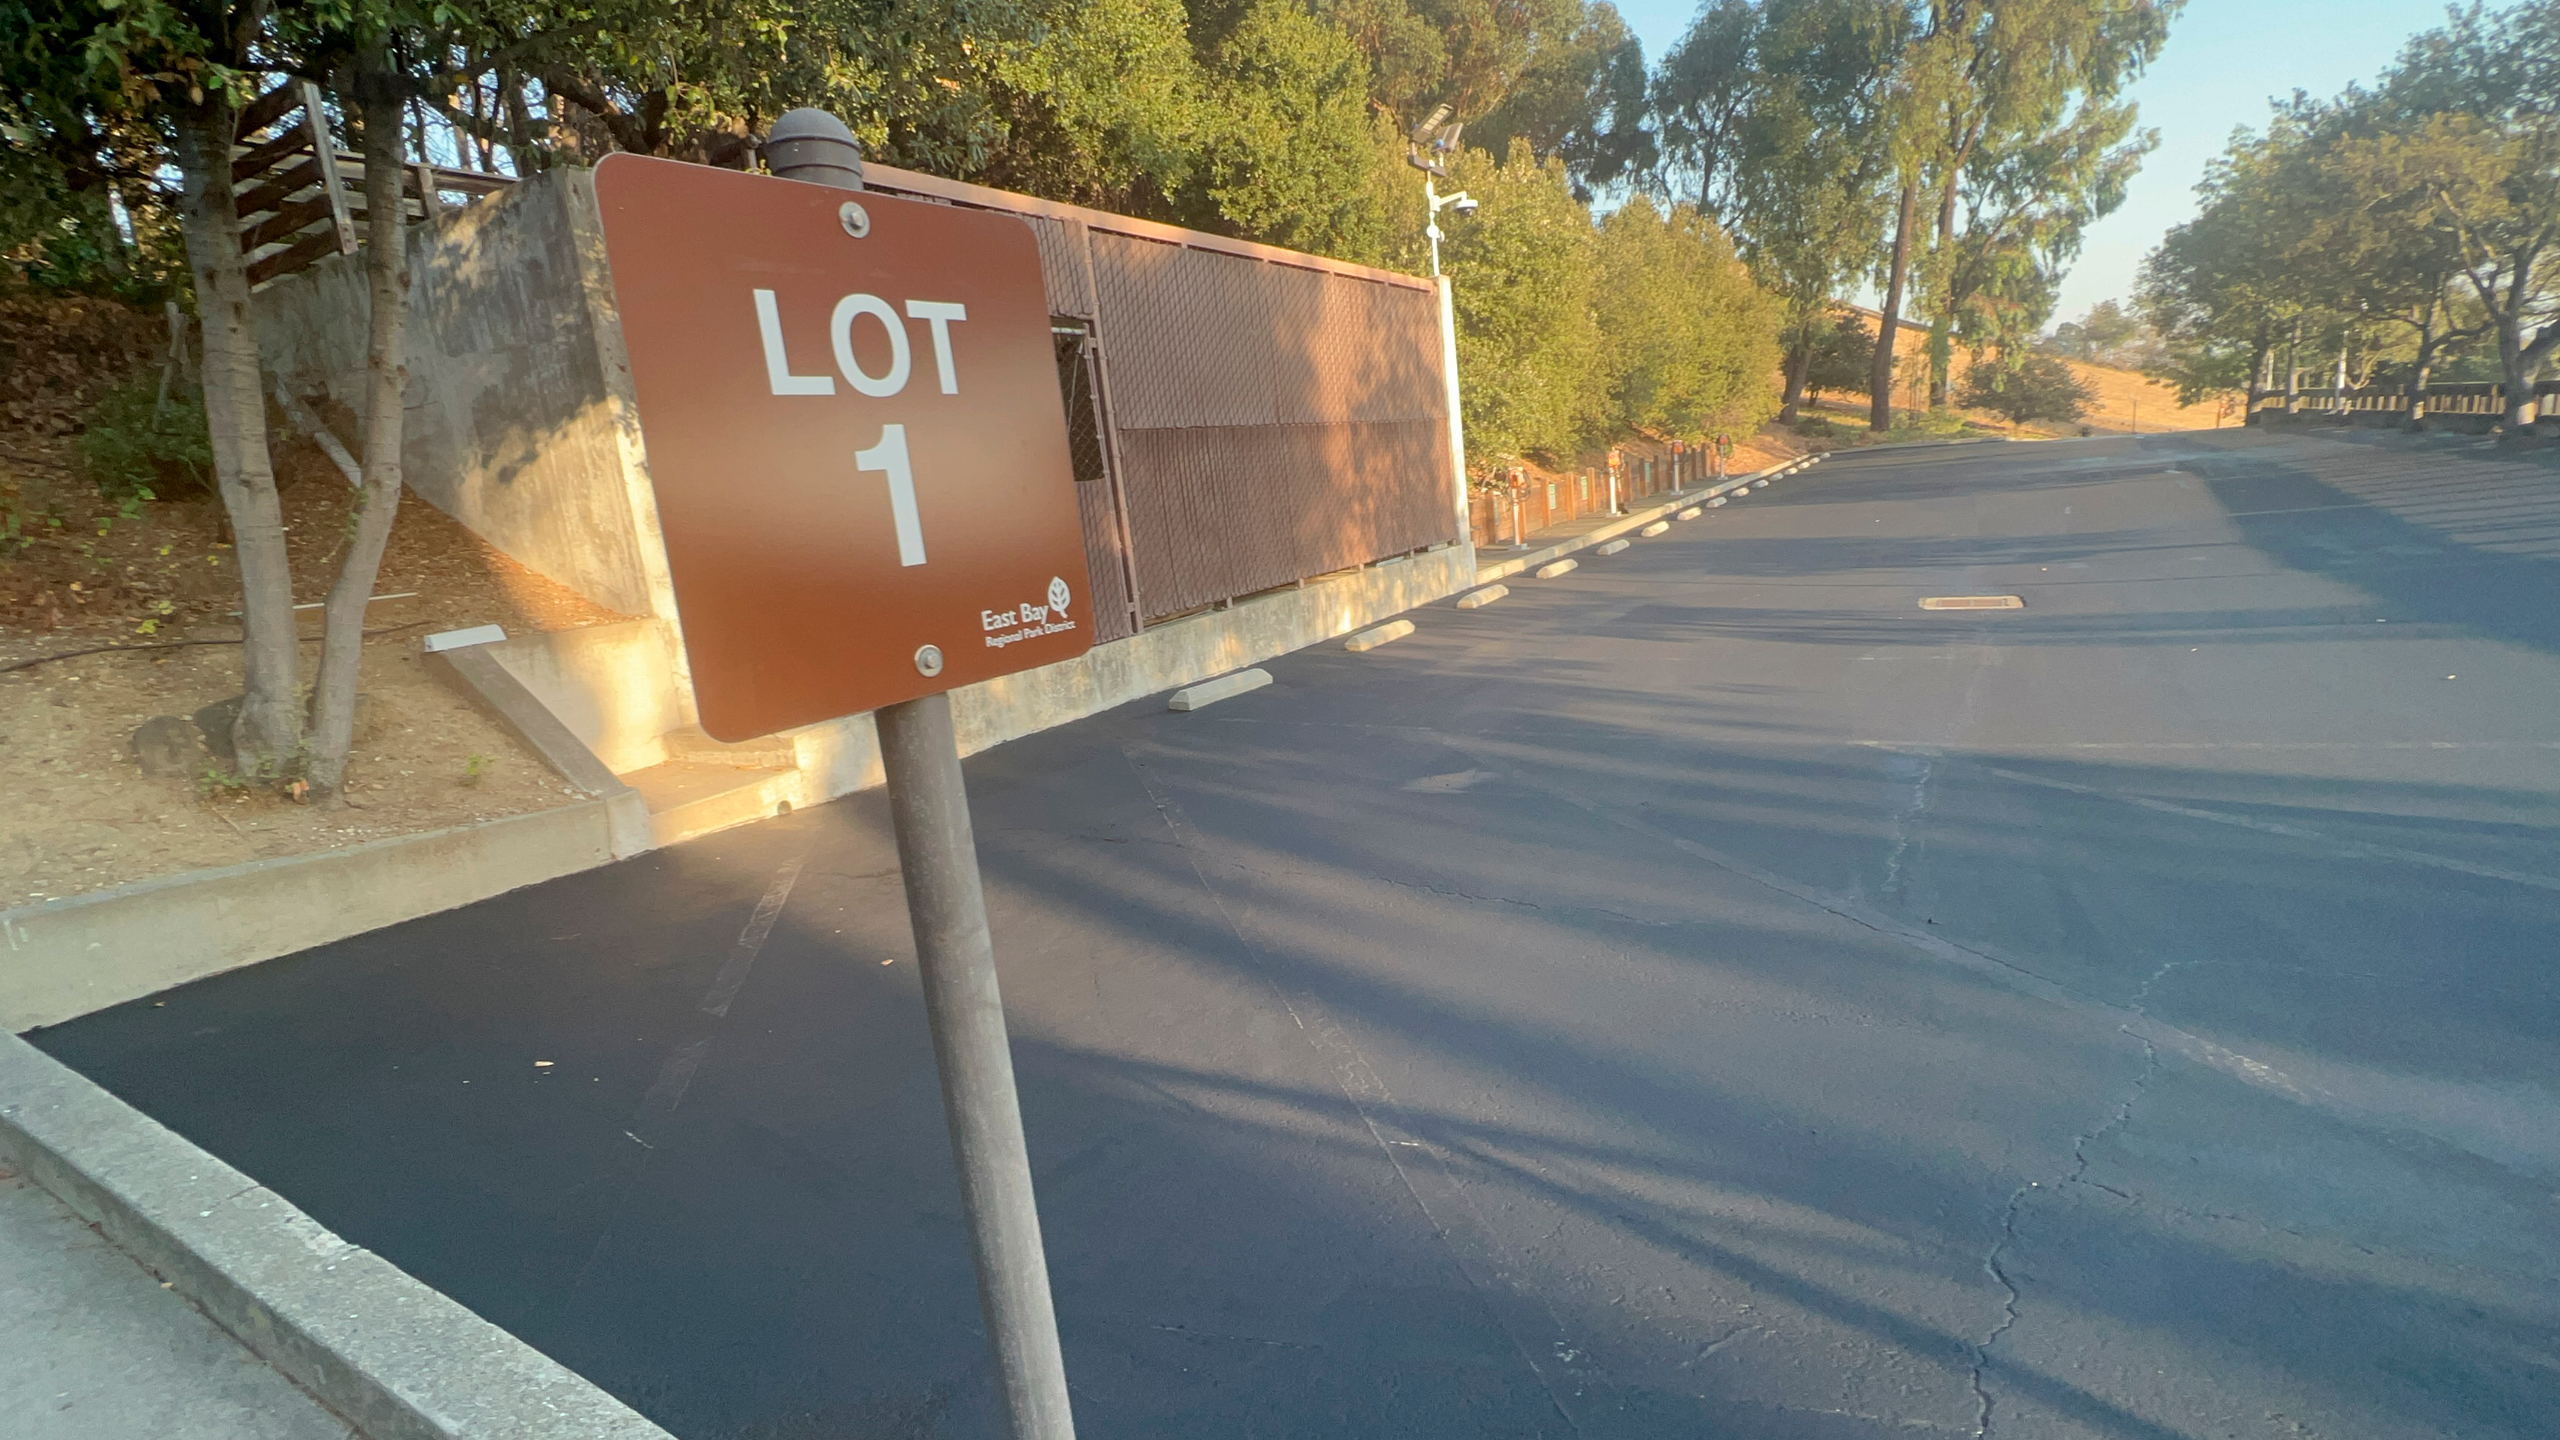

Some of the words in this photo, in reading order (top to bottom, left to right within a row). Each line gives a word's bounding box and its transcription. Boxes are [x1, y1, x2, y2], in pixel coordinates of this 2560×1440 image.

[753, 289, 967, 397] LOT
[855, 423, 927, 567] 1
[981, 610, 1018, 631] East
[1020, 603, 1049, 625] Bay
[985, 630, 1023, 648] Regional
[1023, 626, 1044, 639] Park
[1044, 621, 1076, 634] District
